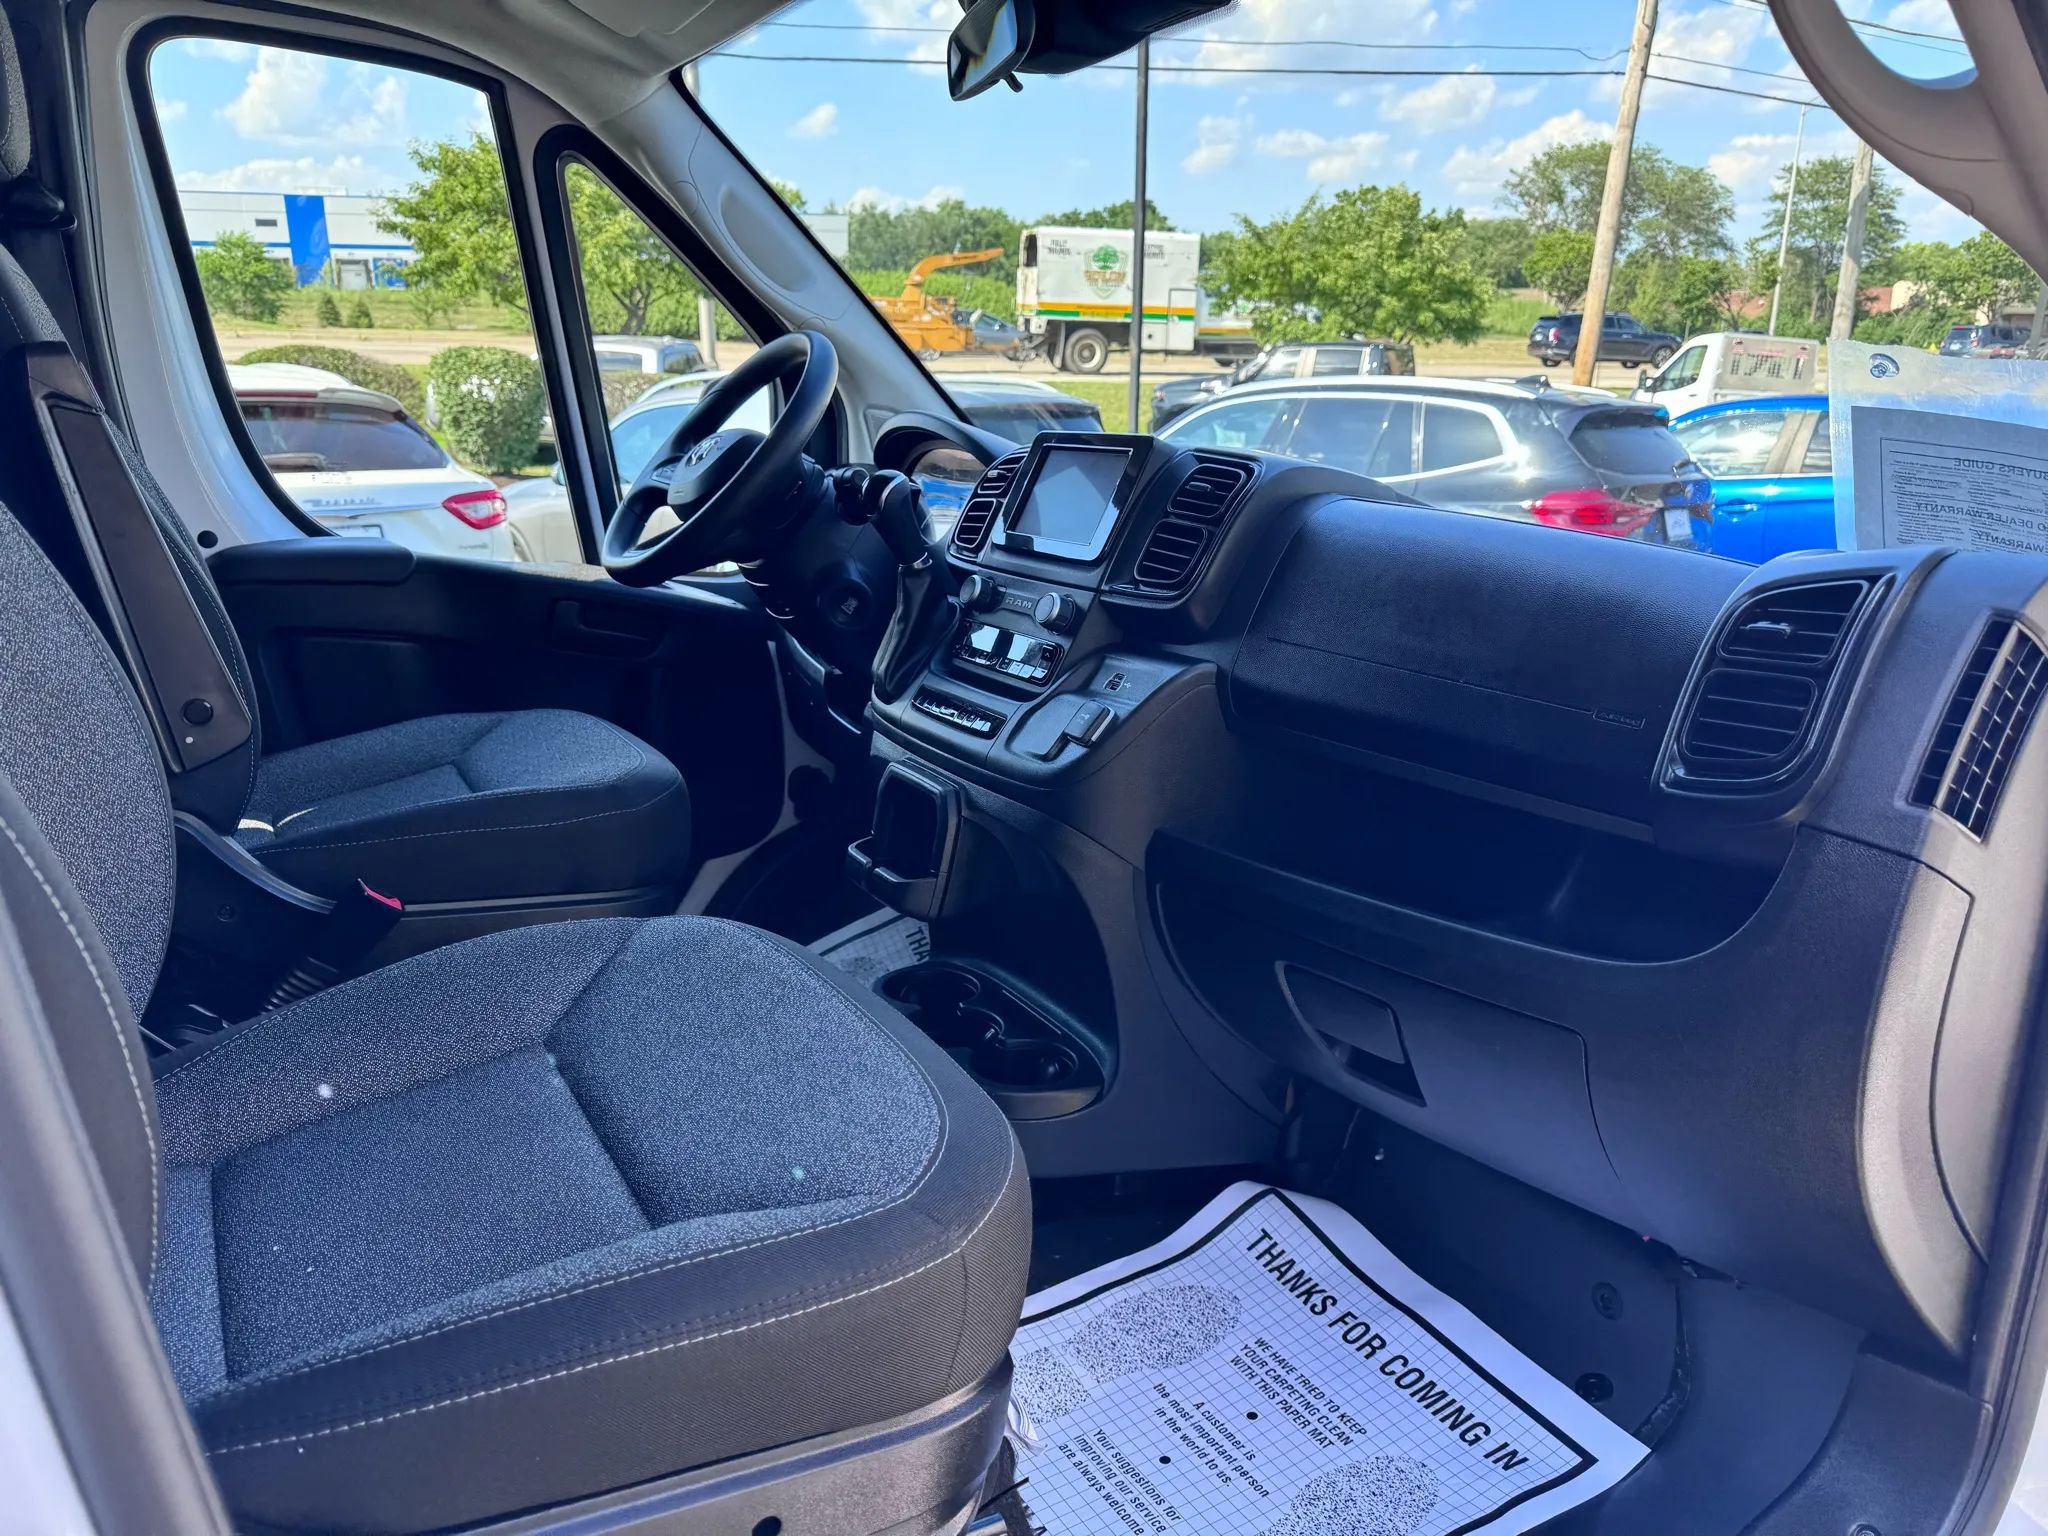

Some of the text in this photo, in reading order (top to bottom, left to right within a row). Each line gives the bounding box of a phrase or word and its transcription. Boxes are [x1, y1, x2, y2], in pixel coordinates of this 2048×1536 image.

[1005, 597, 1033, 609] RAM
[1240, 1344, 1354, 1446] YOUR CARPETING CLEAN
[1246, 1228, 1530, 1472] THANKS FOR COMING IN
[1254, 1337, 1367, 1436] WE HAVE TRIED TO KEEP
[1153, 1383, 1270, 1497] the most important person
[1154, 1407, 1232, 1488] in the world to us.
[1193, 1401, 1256, 1461] A customer is
[1230, 1355, 1335, 1449] WITH THIS PAPER MAT
[1058, 1443, 1145, 1536] are always welcome
[1073, 1434, 1167, 1533] improving our service
[1093, 1429, 1182, 1522] Your suggestions for
